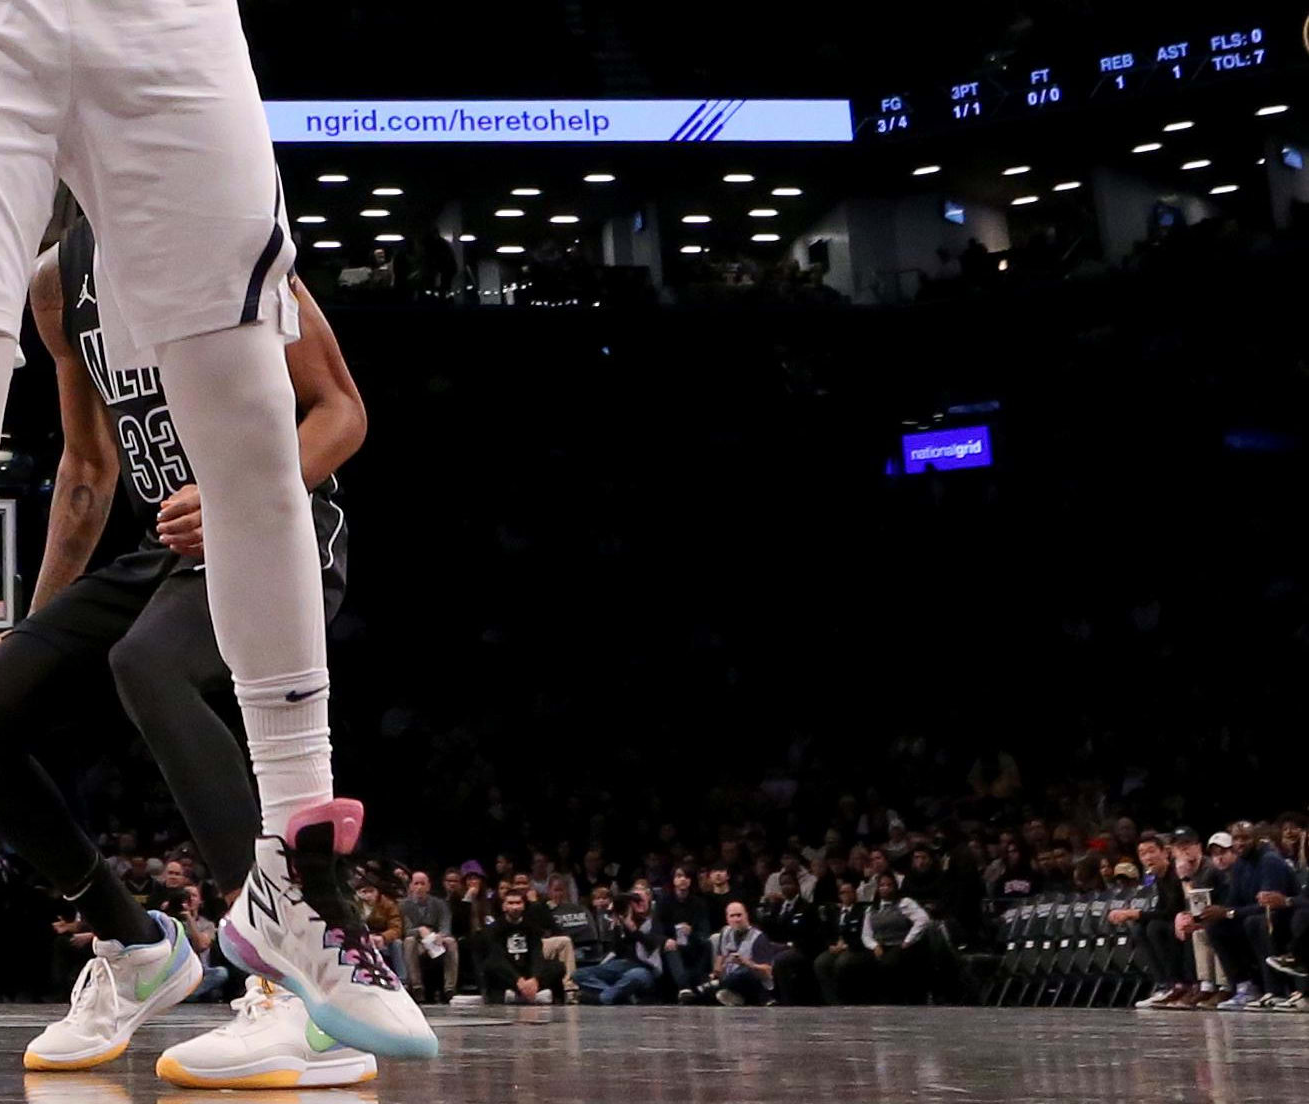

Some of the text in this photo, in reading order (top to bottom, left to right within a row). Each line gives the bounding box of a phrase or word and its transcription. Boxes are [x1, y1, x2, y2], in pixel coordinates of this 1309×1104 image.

[1211, 29, 1262, 50] FLS: 0
[1158, 43, 1188, 61] AST
[1212, 49, 1264, 70] TOL: 7
[1100, 54, 1134, 71] REB
[1031, 69, 1049, 84] FT
[1173, 65, 1180, 78] 1
[952, 83, 978, 99] 3PT
[1116, 76, 1124, 89] 1
[882, 97, 902, 112] FG
[306, 109, 610, 136] ngrid.com/heretohelp
[118, 405, 188, 504] 33
[911, 439, 982, 459] nationalgrid
